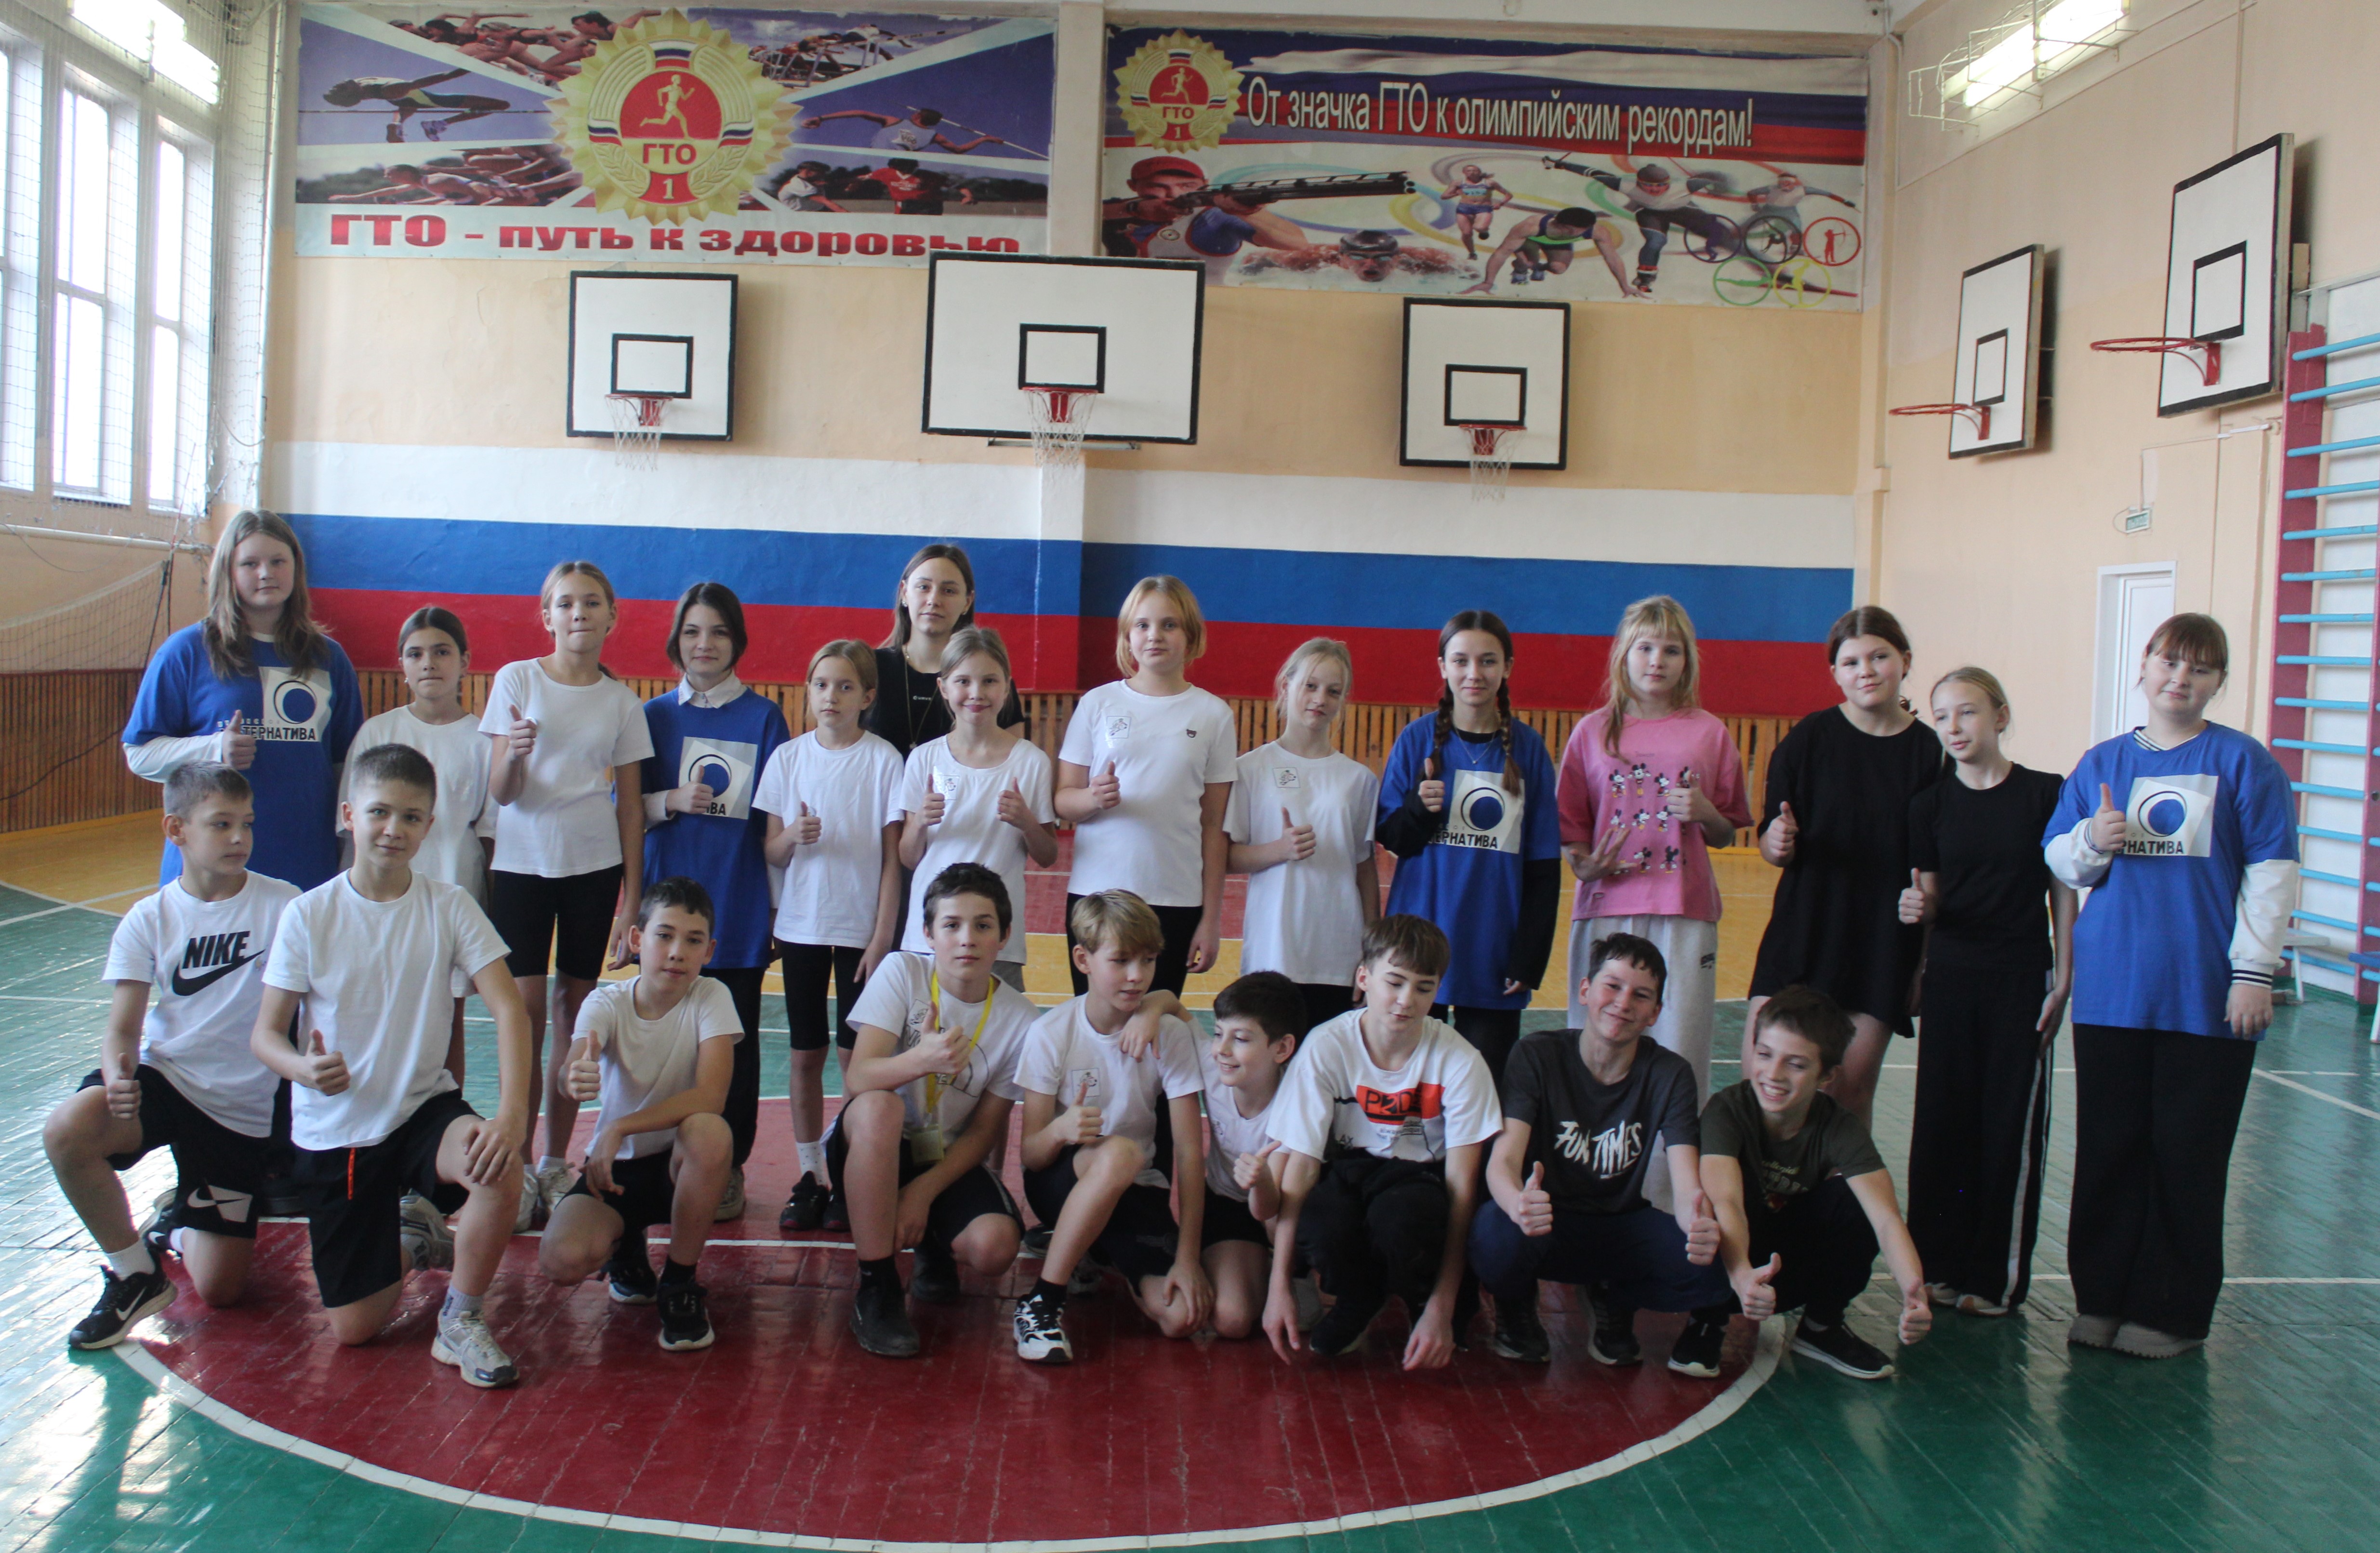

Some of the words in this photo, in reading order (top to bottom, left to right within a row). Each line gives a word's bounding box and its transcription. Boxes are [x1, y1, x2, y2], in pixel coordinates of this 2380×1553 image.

[1162, 106, 1195, 119] ГТО
[1248, 76, 1281, 127] От
[1287, 90, 1371, 130] значка
[1378, 81, 1429, 133] ГТО
[1436, 96, 1449, 133] к
[1455, 89, 1620, 141] олимпийским
[1628, 98, 1753, 158] рекордам!
[1175, 126, 1181, 139] 1
[642, 143, 697, 165] ГТО
[662, 178, 674, 199] 1
[331, 213, 446, 247] ГТО
[499, 226, 634, 251] путь
[650, 227, 693, 250] к
[699, 228, 1020, 257] здоровью
[242, 726, 317, 741] ТЕРНАТИВА
[182, 930, 251, 969] NIKE
[1591, 1119, 1642, 1174] TIMES
